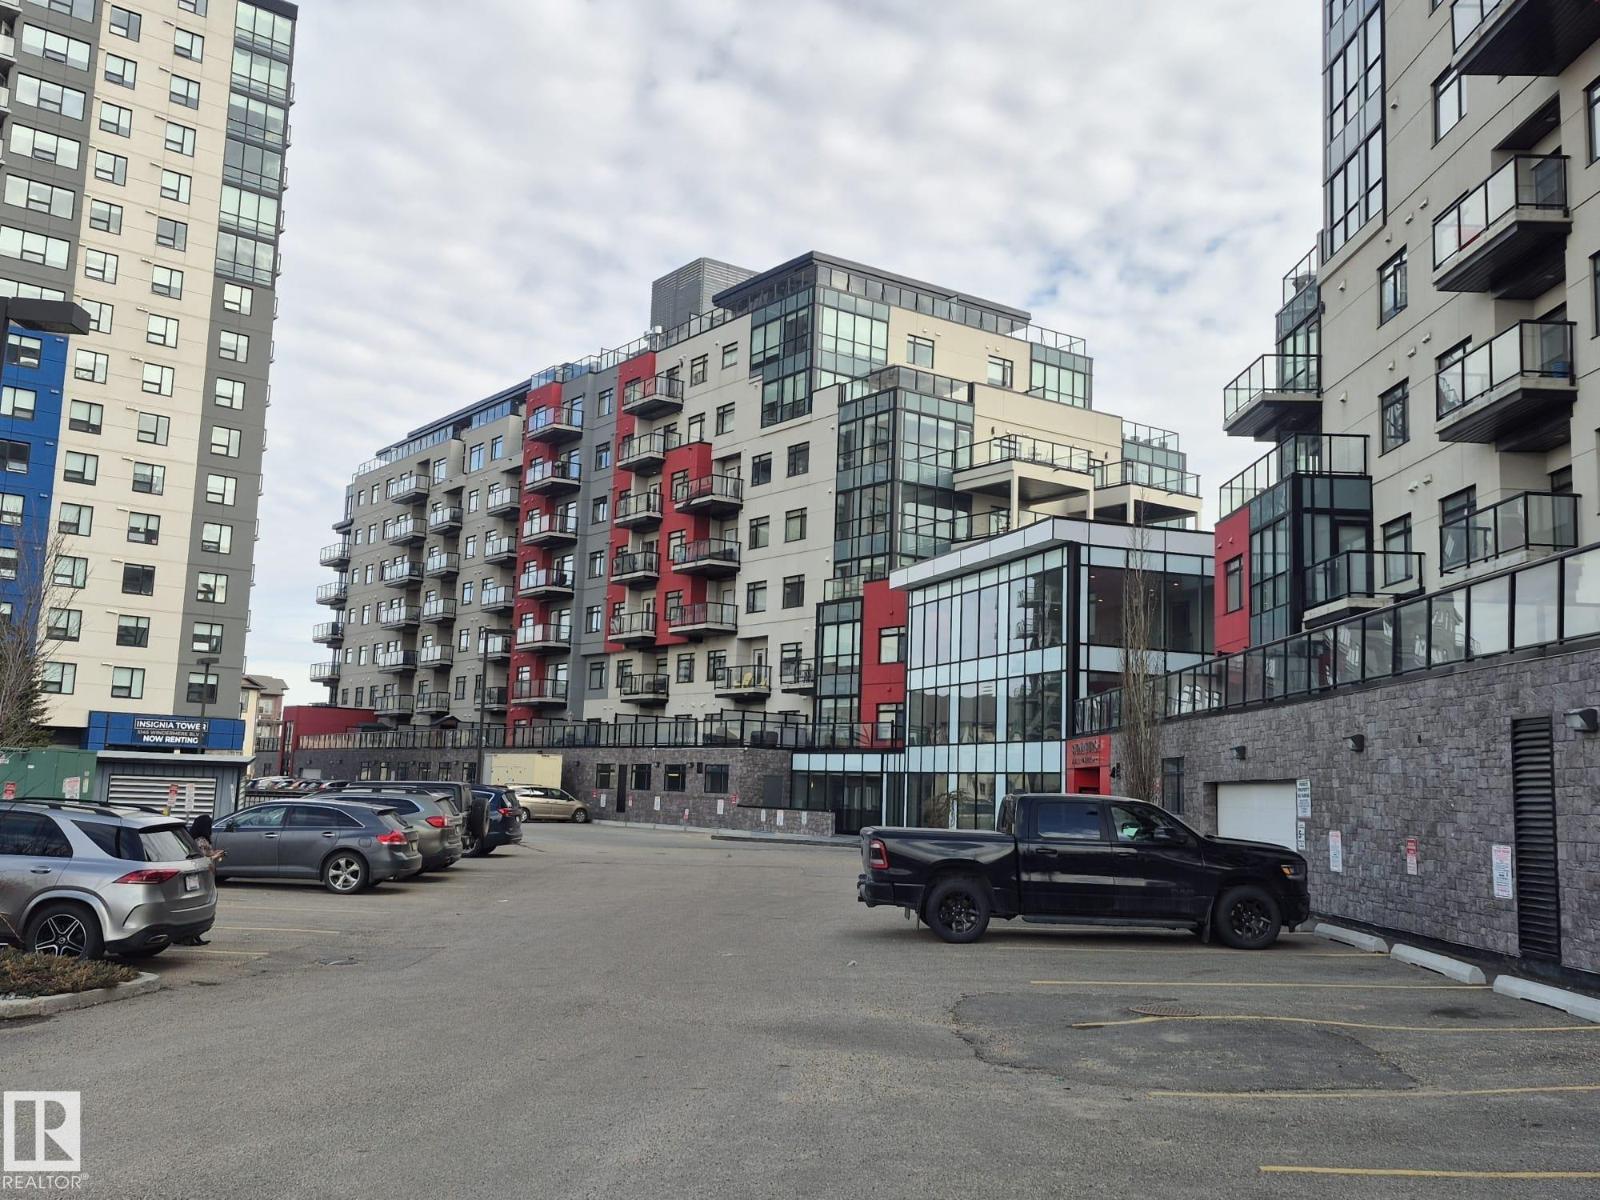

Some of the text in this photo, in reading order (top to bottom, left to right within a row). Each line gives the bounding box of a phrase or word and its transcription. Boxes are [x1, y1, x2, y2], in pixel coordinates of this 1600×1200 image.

[136, 720, 174, 729] INSIGNIA
[143, 735, 199, 744] NOW RENTING
